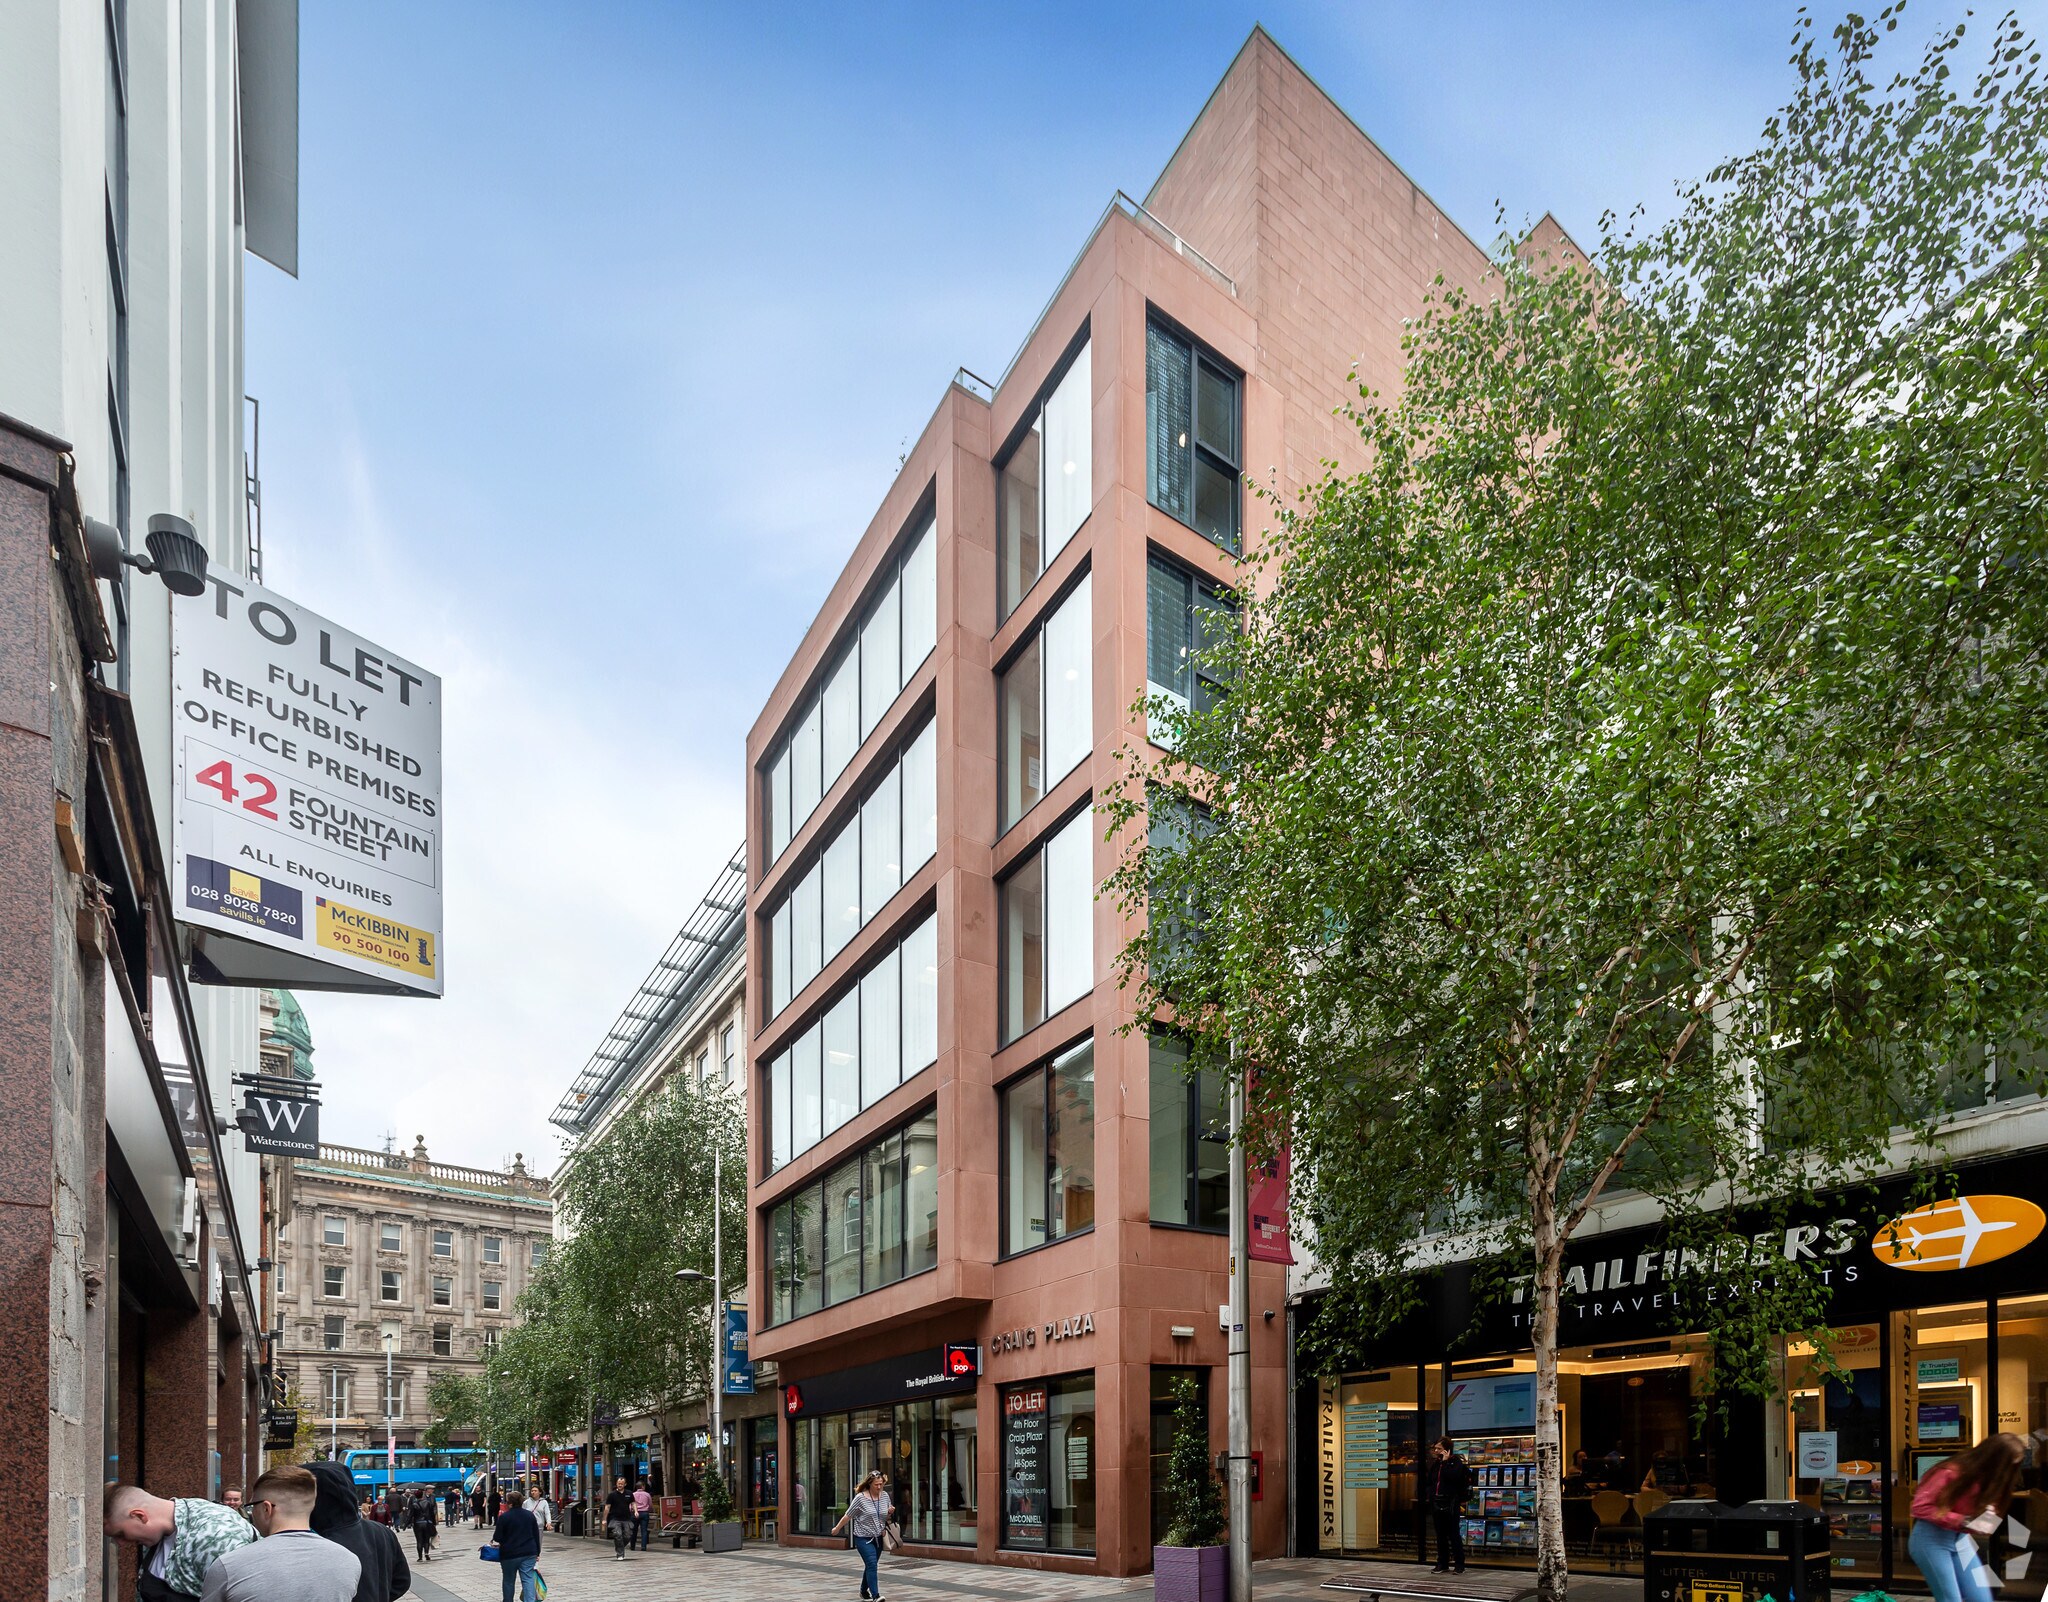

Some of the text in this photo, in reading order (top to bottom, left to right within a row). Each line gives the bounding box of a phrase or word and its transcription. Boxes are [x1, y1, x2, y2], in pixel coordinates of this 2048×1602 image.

[205, 574, 423, 707] TO LET
[267, 663, 369, 722] FULLY
[202, 667, 422, 777] REFURBISHED
[183, 700, 437, 818] OFFICE PREMISES
[195, 760, 279, 822] 42
[289, 788, 430, 858] FOUNTAIN
[289, 810, 393, 862] STREET
[239, 844, 393, 907] ALL ENQUIRIES
[191, 885, 298, 926] 028 9026 7820
[231, 885, 261, 902] savills
[219, 904, 267, 927] savills.ie
[331, 906, 410, 944] McKIBBIN
[332, 931, 410, 963] 90 500 100
[253, 1096, 311, 1134] W
[250, 1134, 316, 1151] Waterstones
[1576, 1291, 1681, 1319] TRAVEL
[991, 1312, 1096, 1354] CRAIG PLAZA
[953, 1363, 969, 1373] pop
[1928, 1361, 1958, 1370] Trustpilot
[905, 1379, 915, 1388] The
[915, 1376, 929, 1387] Royal
[928, 1373, 945, 1385] British
[788, 1400, 798, 1411] pop
[1009, 1391, 1043, 1411] TO LET
[1008, 1431, 1043, 1444] Craig Plaza
[1012, 1419, 1040, 1430] 4th Floor
[1014, 1445, 1037, 1457] Superb
[1014, 1459, 1037, 1470] Hi-Spec
[1322, 1387, 1335, 1537] TRAILFINDERS
[1015, 1472, 1036, 1481] Offices
[1662, 1567, 1776, 1582] LITTER LITTER
